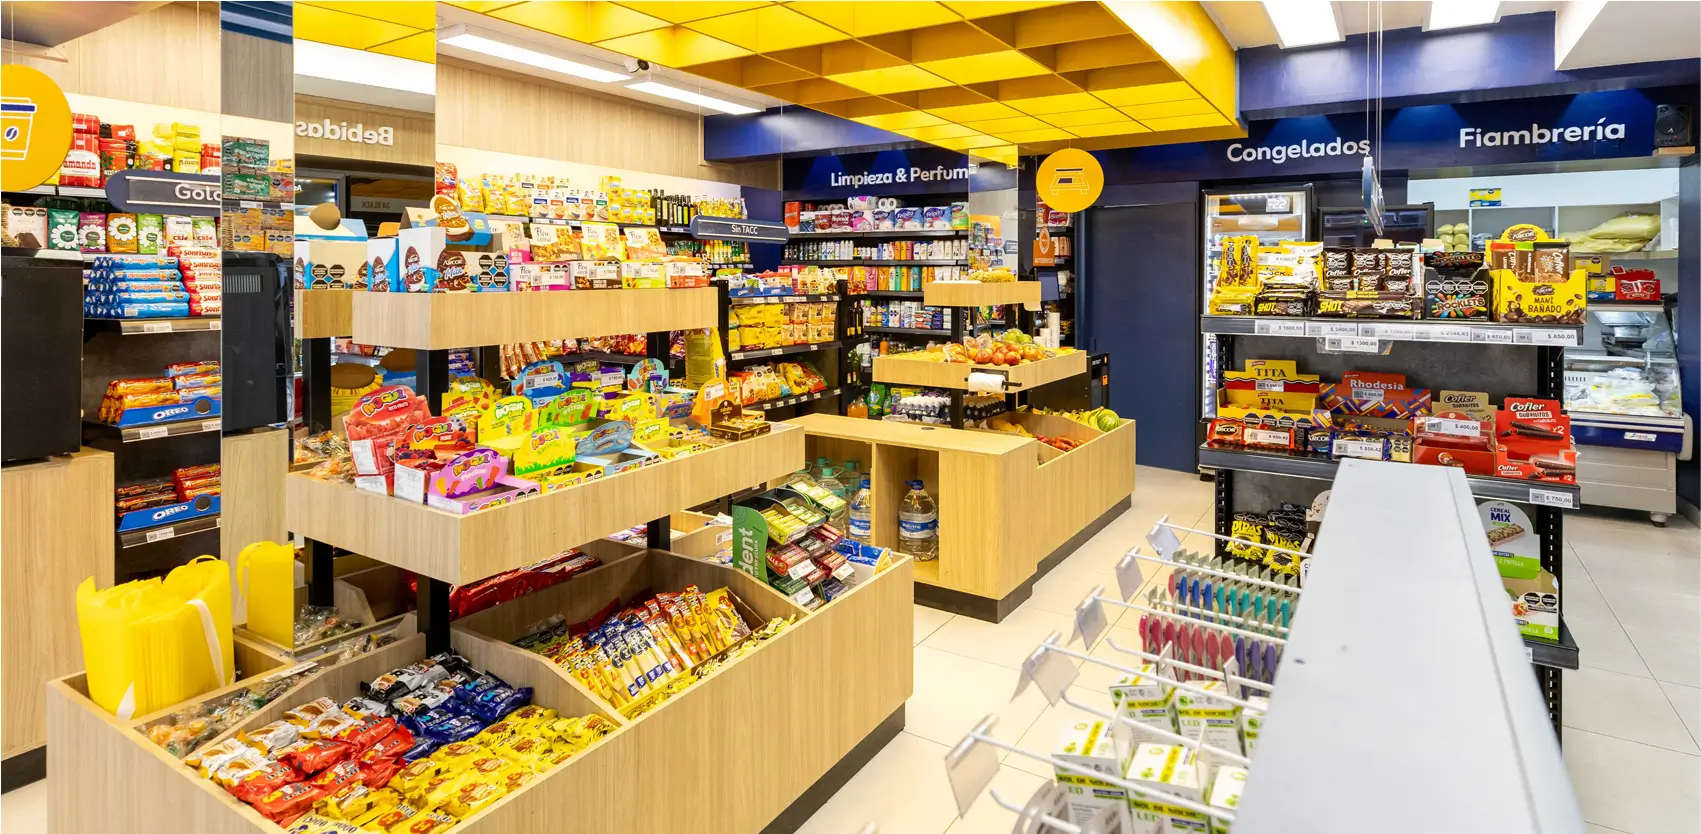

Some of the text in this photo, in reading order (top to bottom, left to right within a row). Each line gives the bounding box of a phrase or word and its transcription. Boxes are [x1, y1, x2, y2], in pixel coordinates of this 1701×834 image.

[1459, 117, 1625, 148] Fiambrería
[1226, 137, 1371, 163] Congelados
[831, 171, 894, 189] Limpieza
[896, 168, 907, 182] &
[731, 224, 758, 235] Sin TACC
[1257, 303, 1277, 313] SHOT
[1320, 301, 1344, 313] SHOT
[1436, 297, 1485, 311] ROCKLETS
[1528, 304, 1562, 313] BAÑADO
[1254, 368, 1287, 378] TITA
[1350, 380, 1404, 391] Rhodesia
[361, 388, 409, 418] MOGUL
[1445, 394, 1477, 404] Cofler
[1510, 402, 1545, 412] Cofler
[152, 406, 189, 421] OREO
[413, 422, 454, 444] MOGUL
[1553, 426, 1564, 435] x2
[452, 454, 492, 477] MOGUL
[152, 504, 189, 520] OREO
[1490, 513, 1511, 523] MIX
[766, 555, 778, 565] ALLS
